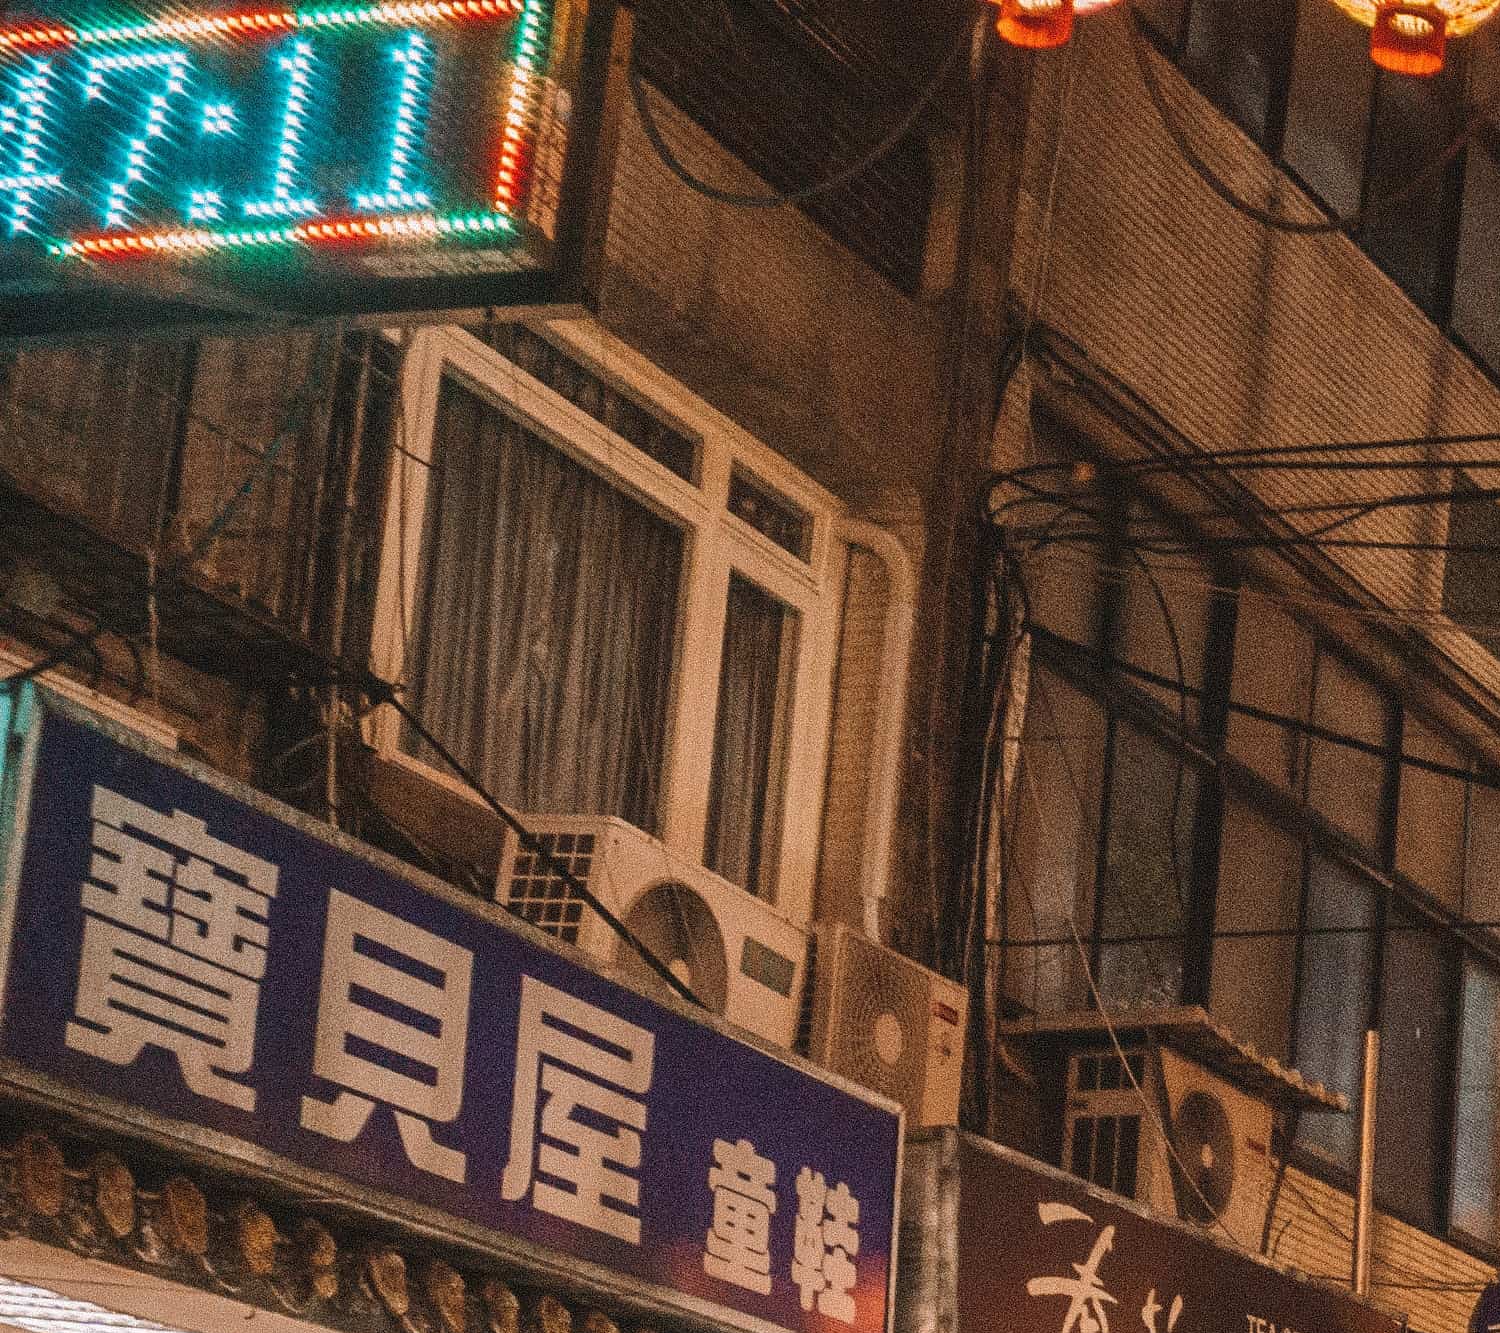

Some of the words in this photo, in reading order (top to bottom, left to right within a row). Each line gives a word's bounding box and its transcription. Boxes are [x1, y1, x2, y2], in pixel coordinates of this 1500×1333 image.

[64, 783, 657, 1246] 寶貝屋
[706, 1136, 864, 1326] 童鞋
